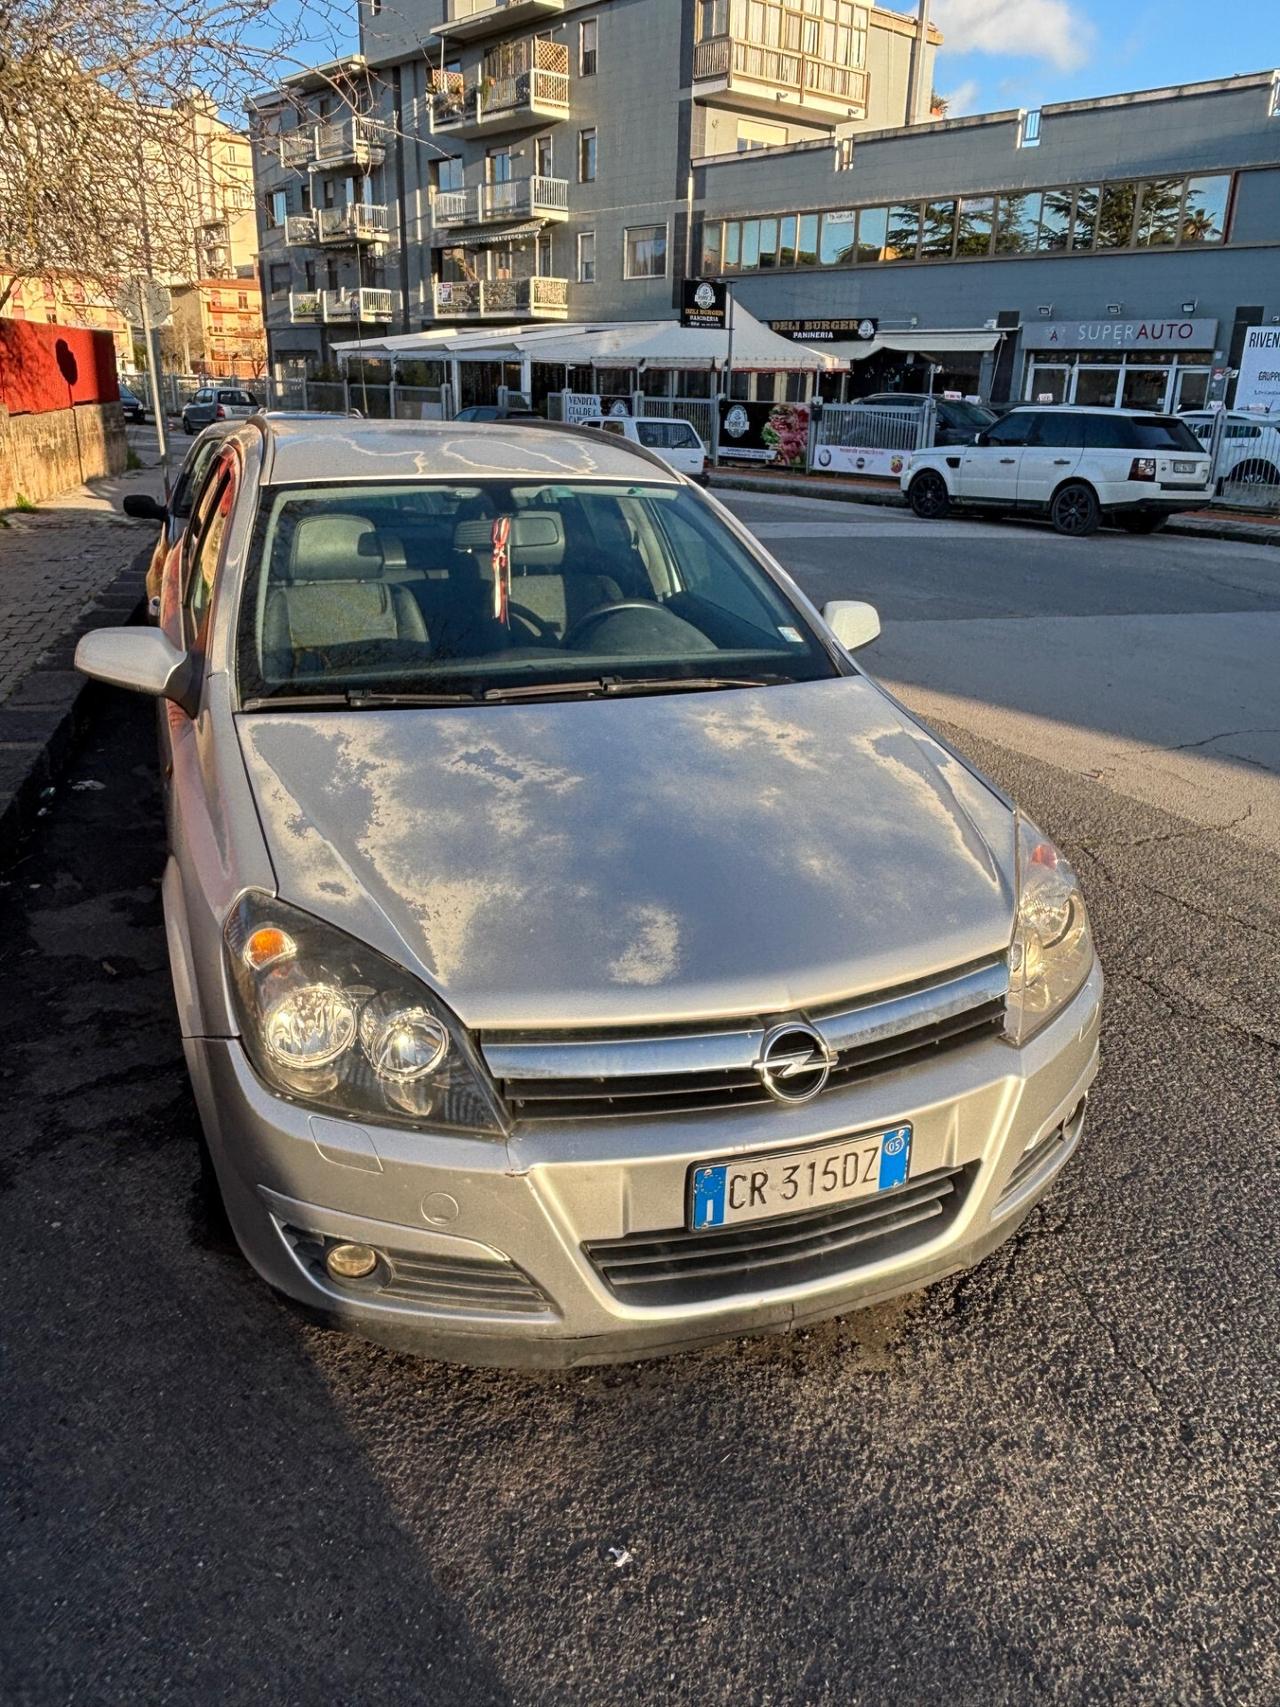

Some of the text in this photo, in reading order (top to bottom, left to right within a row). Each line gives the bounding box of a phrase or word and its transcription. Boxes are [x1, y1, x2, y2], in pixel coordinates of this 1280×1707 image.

[772, 320, 859, 330] DELI BURGER
[793, 331, 834, 339] PANINERIA
[1078, 323, 1194, 341] SUPERAUTO
[1249, 331, 1280, 348] RIVEN
[568, 396, 597, 406] VENDITA
[888, 1140, 902, 1152] 05
[728, 1146, 880, 1210] CR 315DZ
